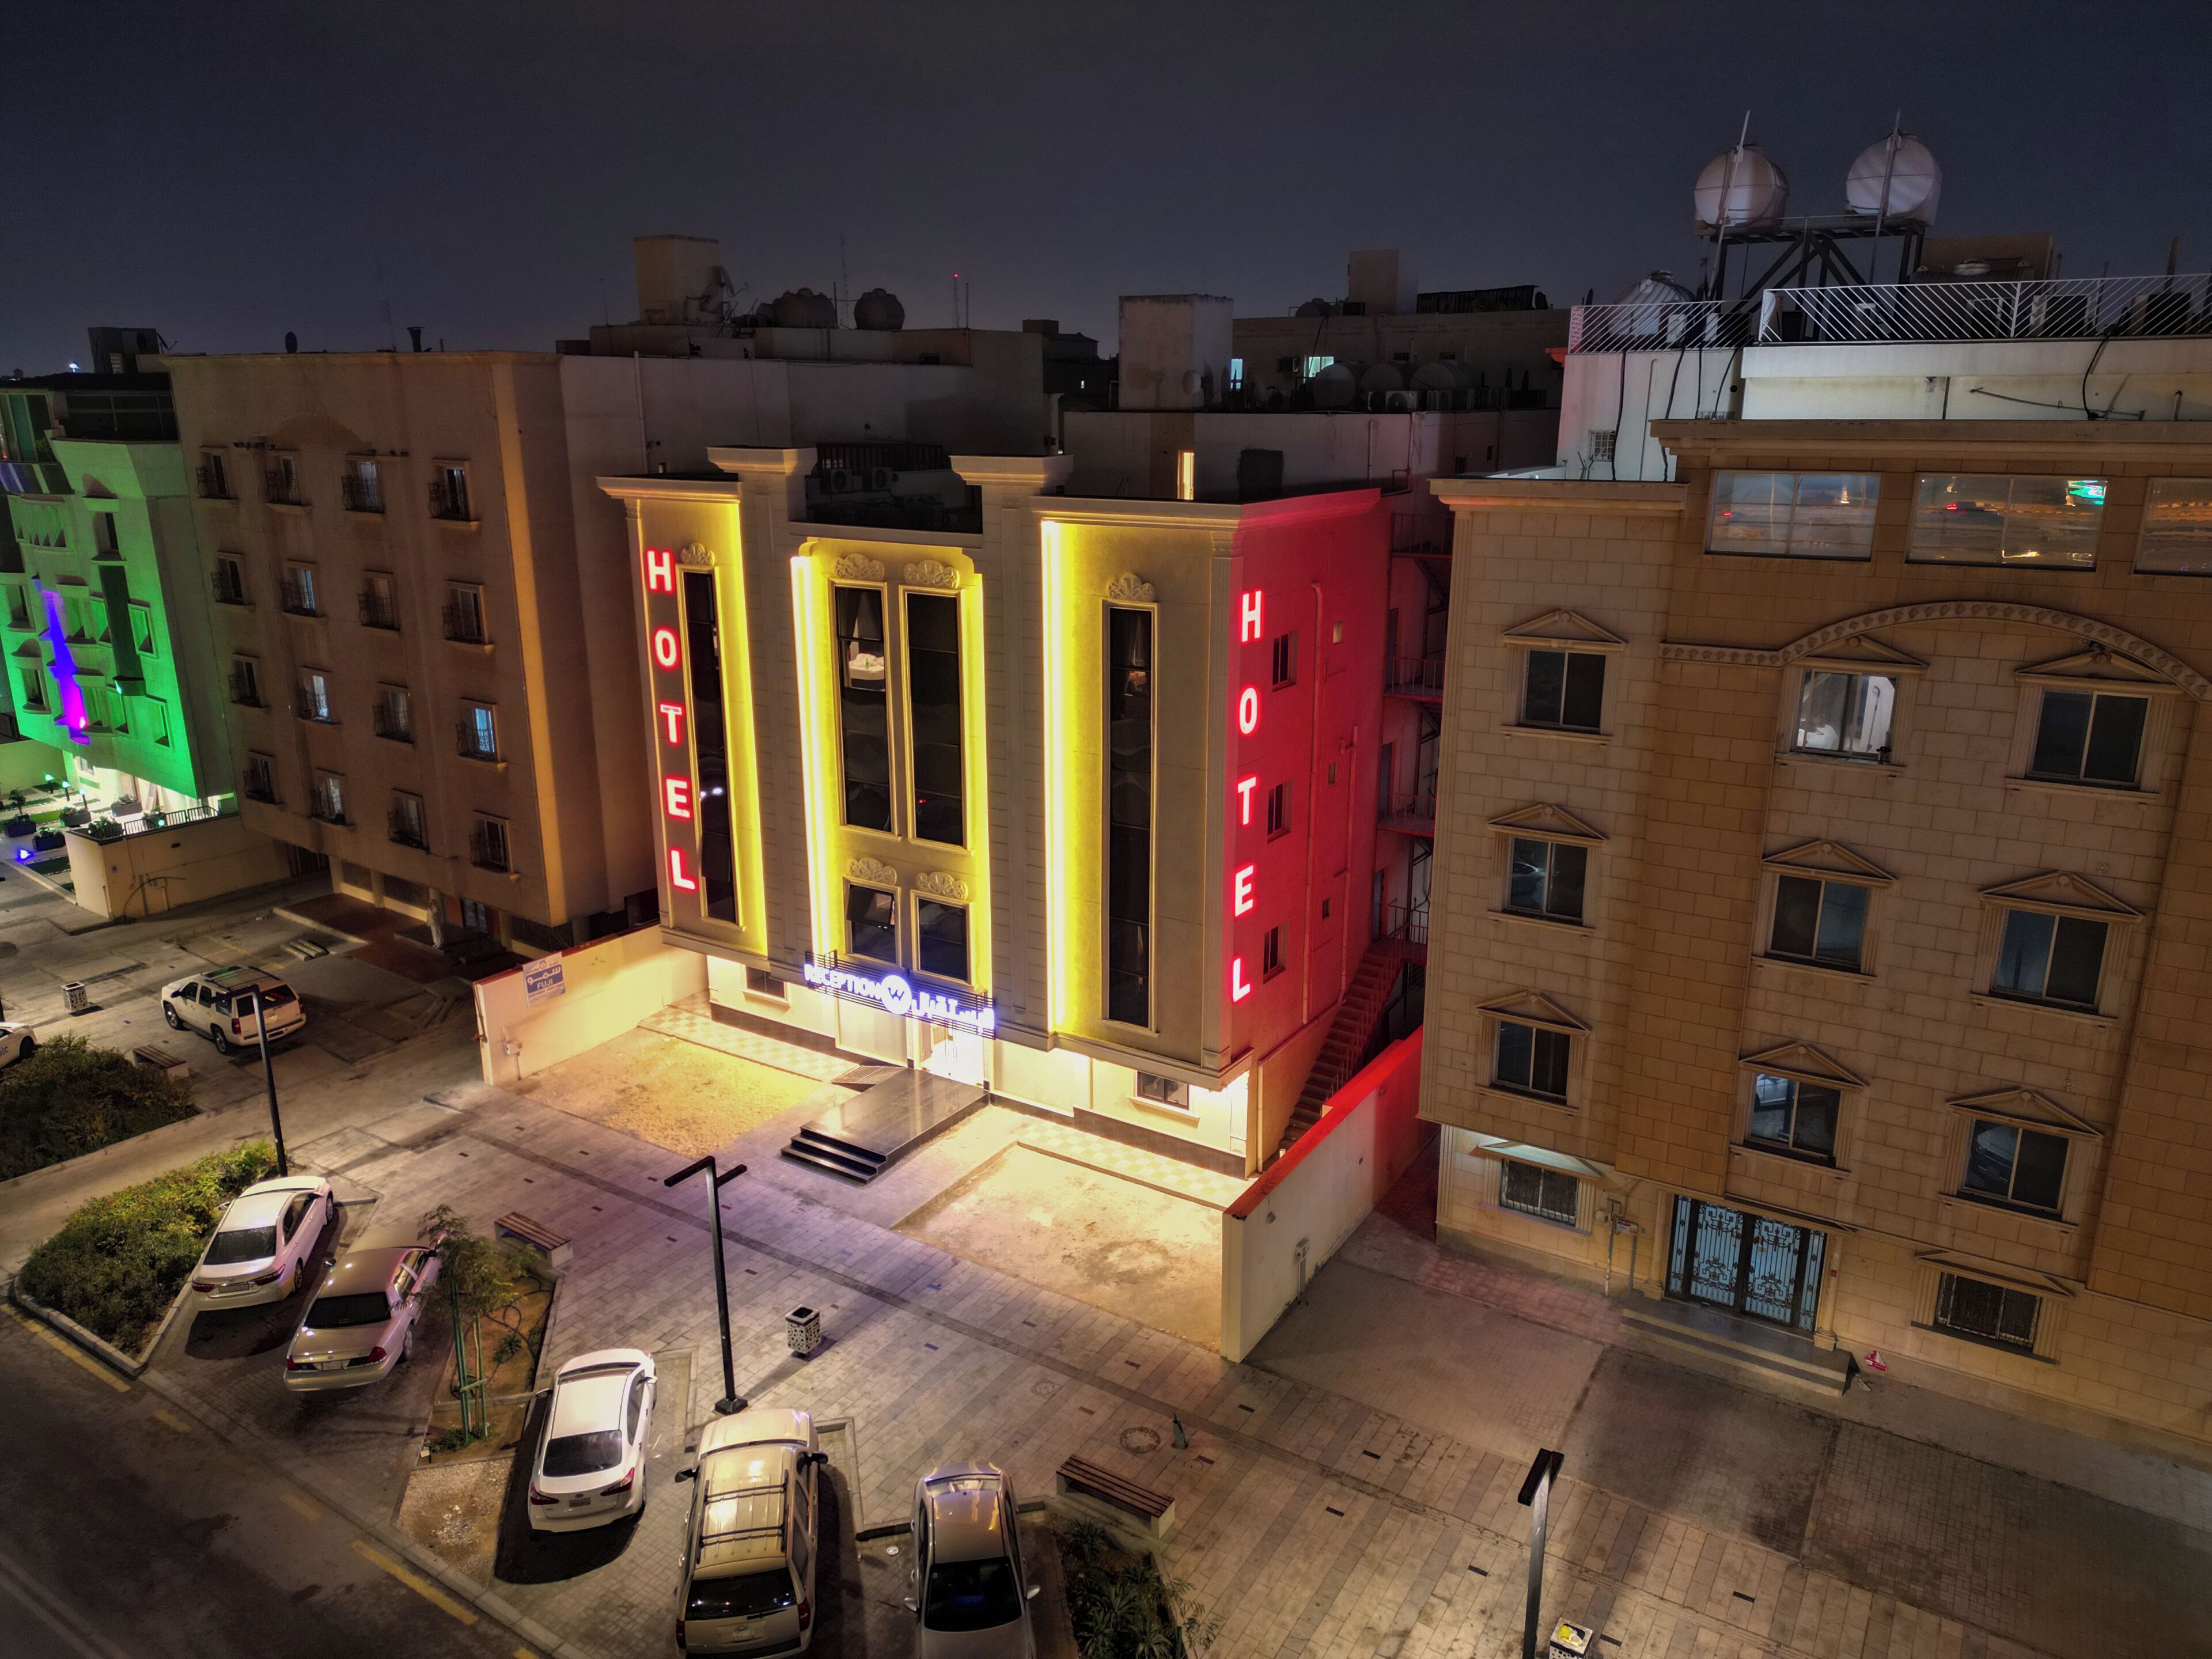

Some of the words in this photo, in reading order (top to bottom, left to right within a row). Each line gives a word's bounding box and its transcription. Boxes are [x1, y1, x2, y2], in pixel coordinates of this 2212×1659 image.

[646, 550, 696, 891] HOTEL
[1232, 590, 1263, 1003] HOTEL
[537, 978, 554, 990] FUJI
